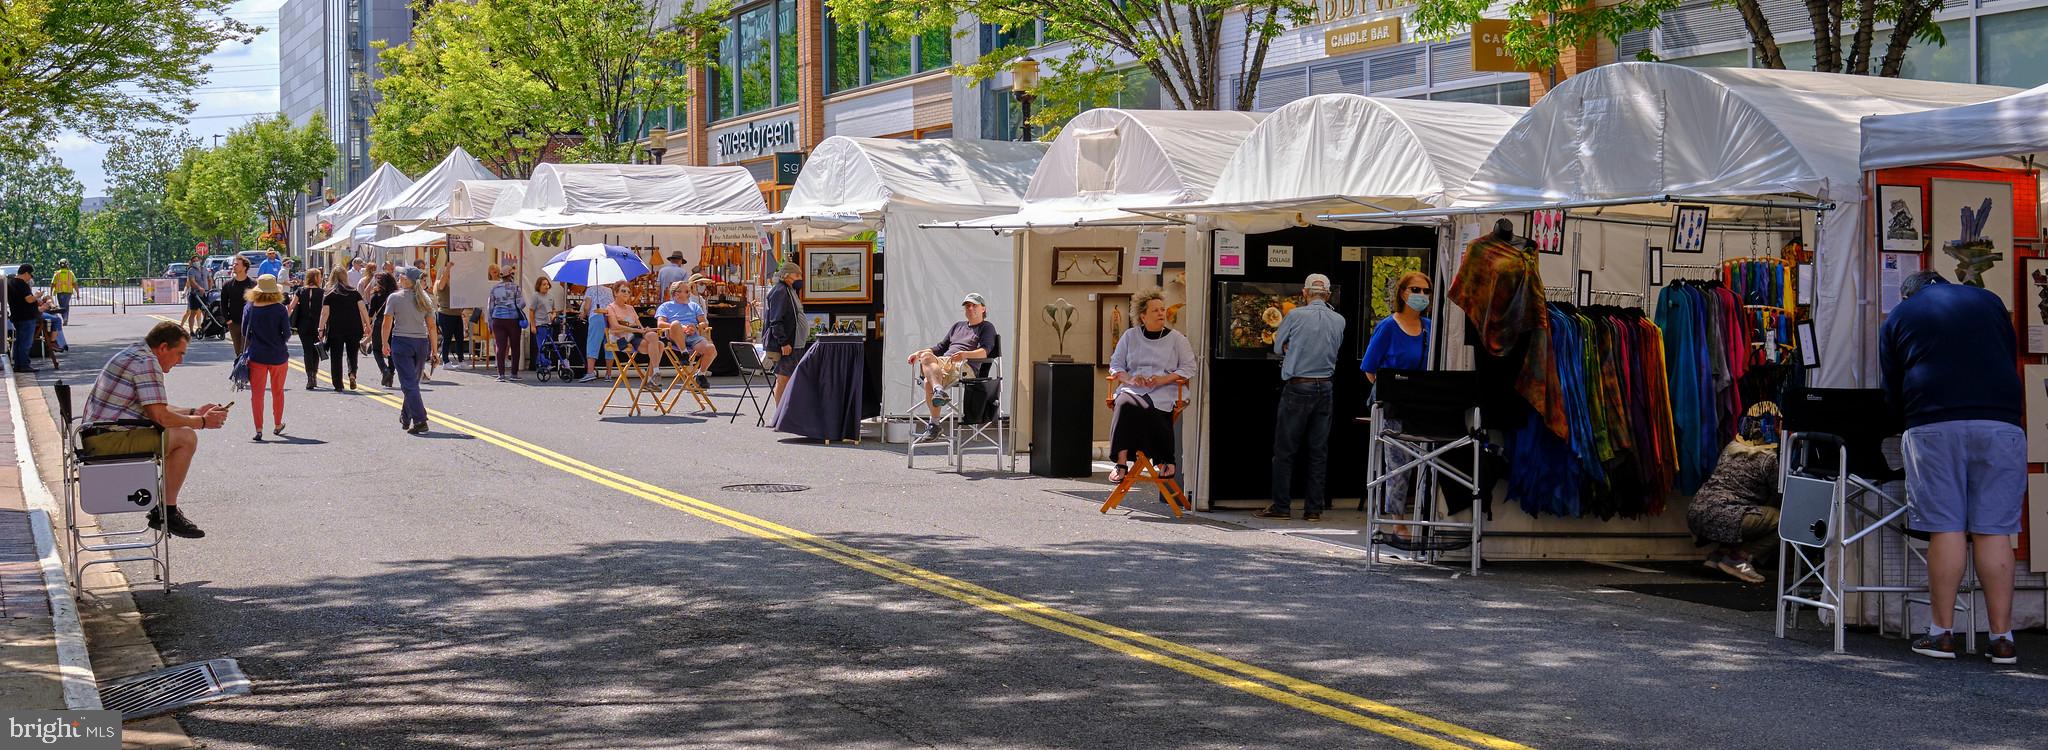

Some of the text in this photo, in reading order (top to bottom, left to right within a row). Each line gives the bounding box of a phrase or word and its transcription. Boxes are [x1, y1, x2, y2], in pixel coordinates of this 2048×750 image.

[1331, 25, 1390, 48] CANDLE BAR
[717, 120, 794, 156] sweetgreen
[783, 163, 800, 175] sg
